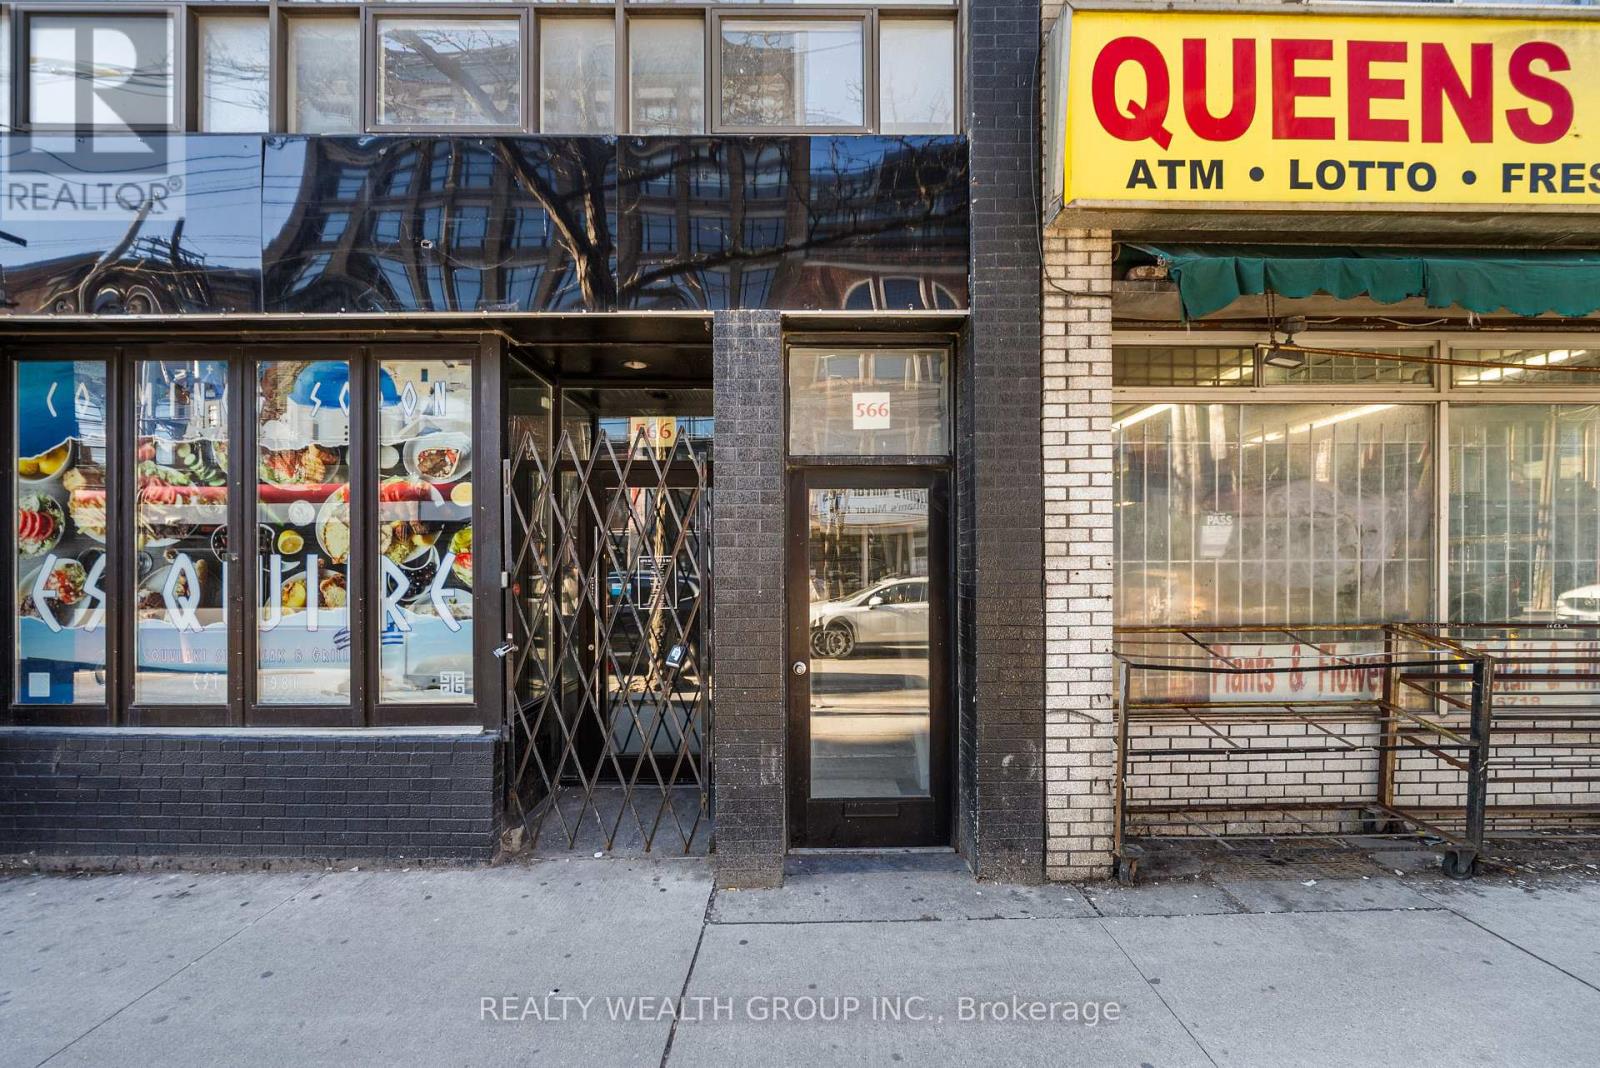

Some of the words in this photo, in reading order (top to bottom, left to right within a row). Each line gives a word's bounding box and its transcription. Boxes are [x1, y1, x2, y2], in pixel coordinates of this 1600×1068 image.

[1091, 36, 1575, 151] QUEENS
[1126, 159, 1224, 190] ATM
[1289, 159, 1438, 193] LOTTO
[855, 402, 889, 417] 566
[1207, 515, 1232, 526] PASS
[32, 552, 462, 633] ESQUIRE
[1212, 643, 1275, 694] Plants
[1288, 643, 1305, 693] &
